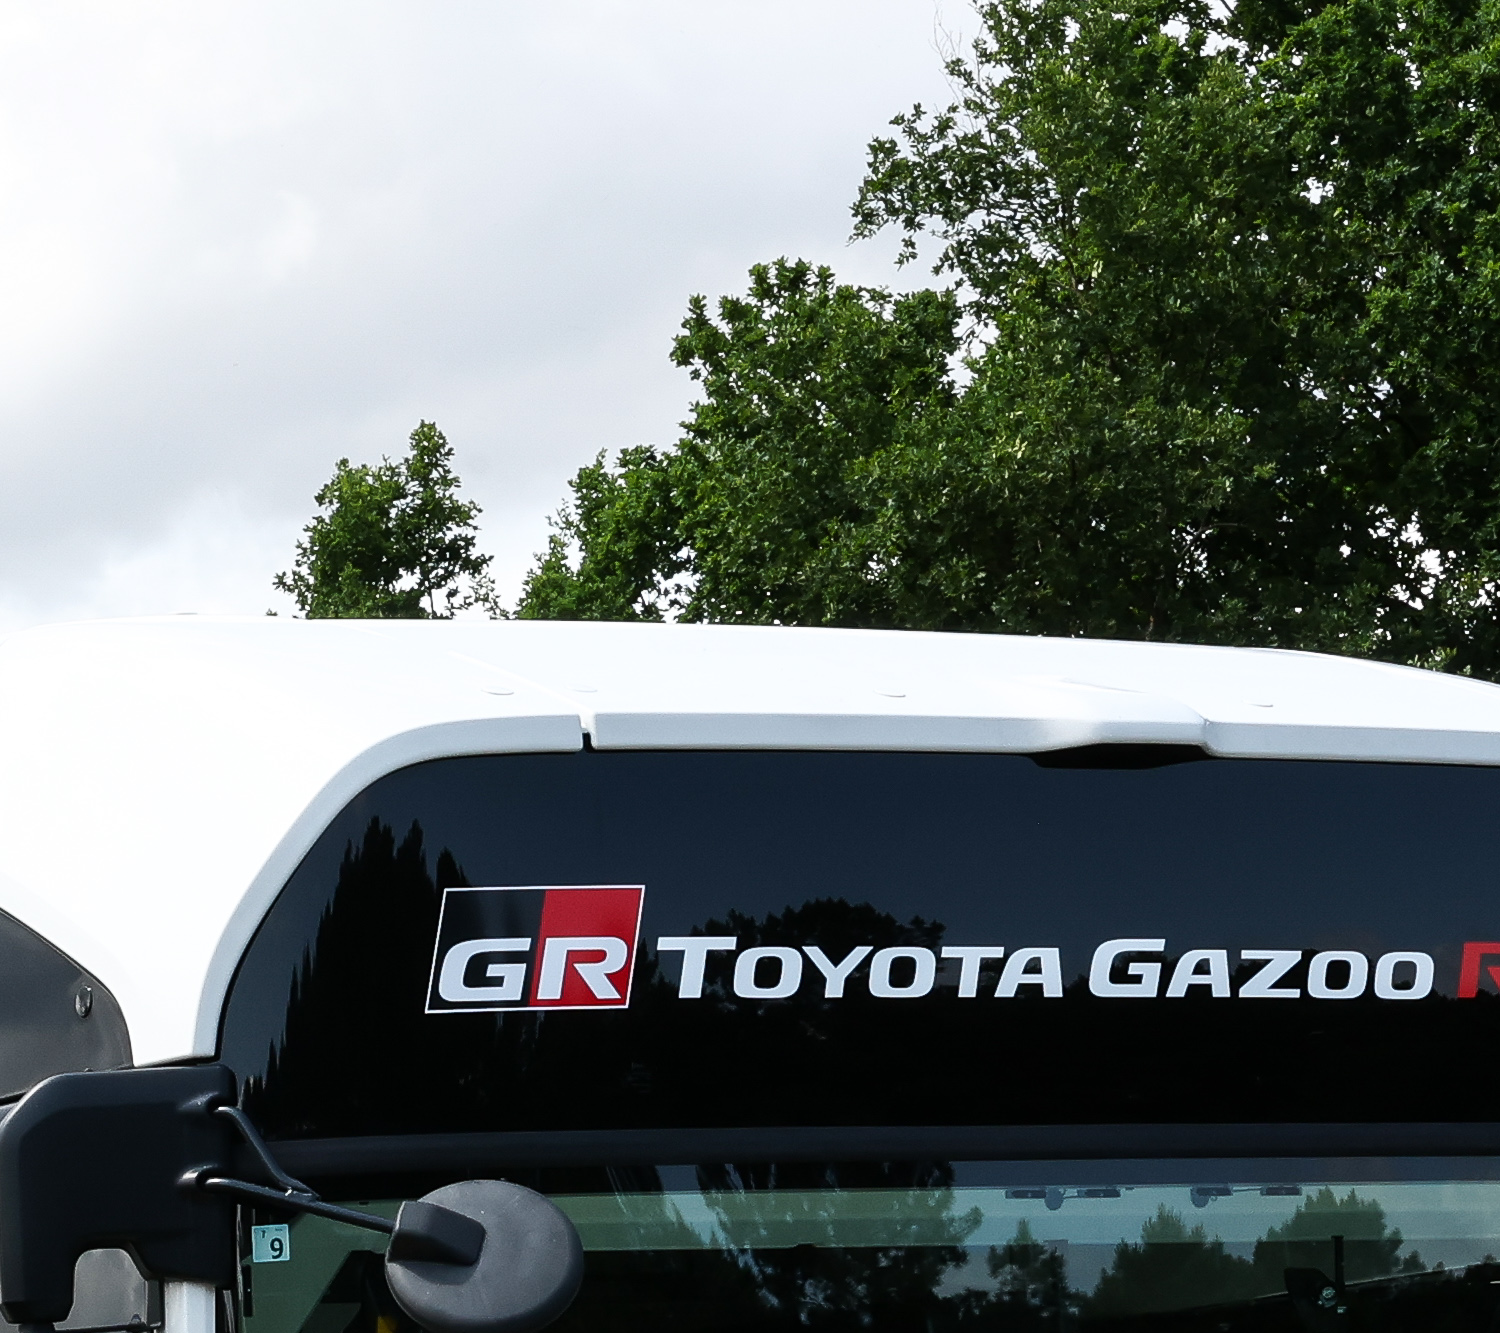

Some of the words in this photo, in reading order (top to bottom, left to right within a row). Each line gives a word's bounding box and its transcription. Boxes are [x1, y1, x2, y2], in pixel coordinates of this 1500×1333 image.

[438, 936, 628, 1002] GR
[656, 936, 1064, 999] TOYOTA
[1088, 938, 1435, 1000] GAZOO
[270, 1238, 284, 1259] 9
